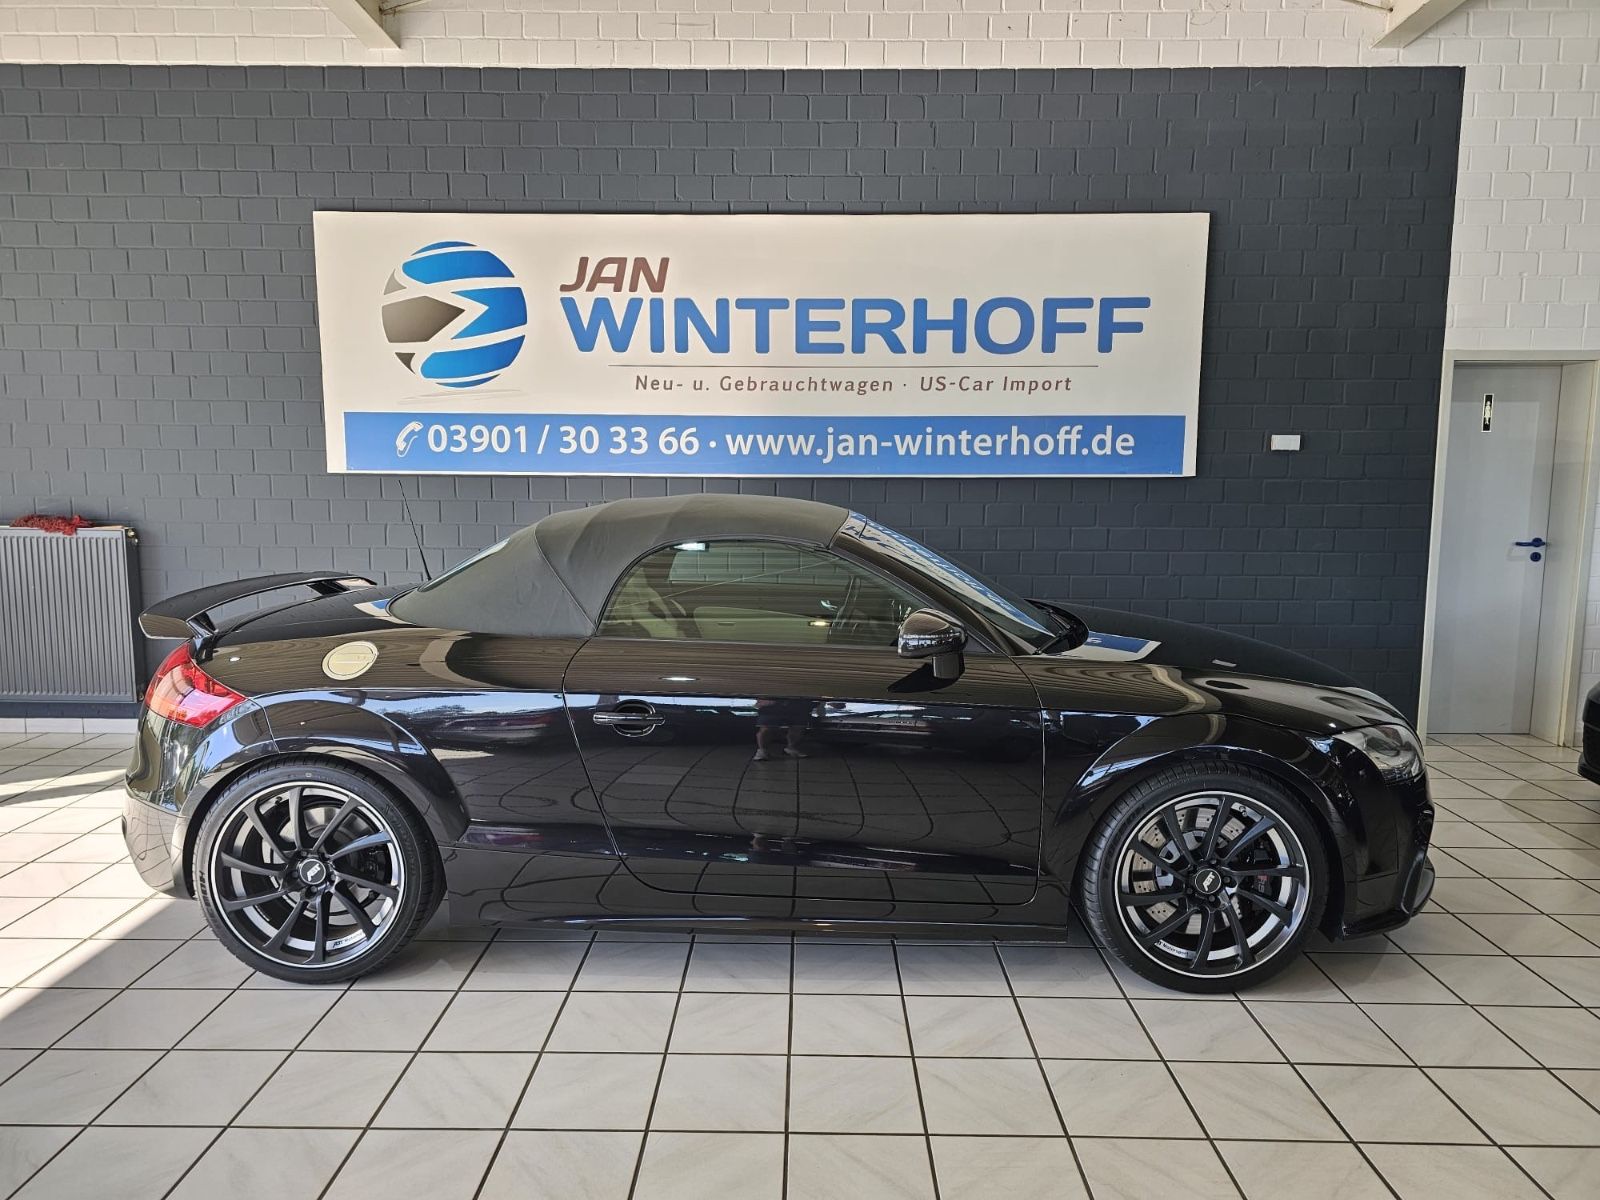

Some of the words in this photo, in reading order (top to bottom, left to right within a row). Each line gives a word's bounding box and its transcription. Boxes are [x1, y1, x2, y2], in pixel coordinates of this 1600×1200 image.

[560, 256, 669, 293] JAN
[560, 297, 1151, 355] WINTERHOFF
[635, 375, 683, 391] Neu-
[693, 379, 709, 391] u.
[719, 375, 893, 396] Gebrauchtwagen
[920, 375, 994, 392] US-Car
[1002, 375, 1072, 396] Import
[427, 424, 527, 454] 03901
[559, 425, 600, 455] 30
[608, 426, 649, 455] 33
[658, 426, 700, 456] 66
[724, 425, 1135, 464] www.jan-winterhoff.de
